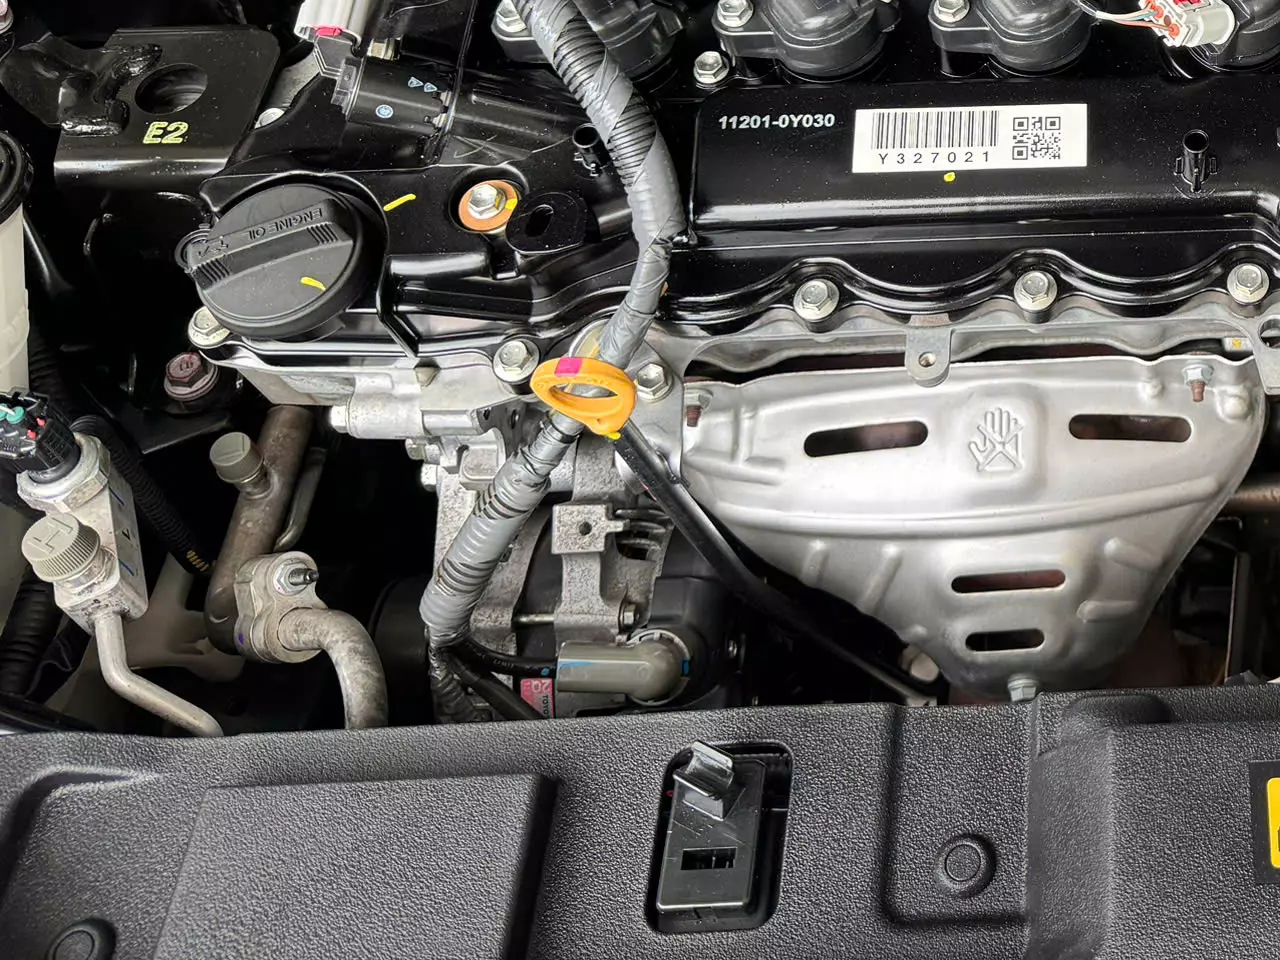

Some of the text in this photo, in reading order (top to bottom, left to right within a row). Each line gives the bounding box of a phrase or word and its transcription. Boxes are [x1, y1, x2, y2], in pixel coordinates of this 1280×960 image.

[718, 114, 835, 130] 11201-0Y030
[143, 121, 189, 144] E2
[878, 151, 991, 165] Y327021
[243, 208, 323, 241] ENGINE OIL
[542, 695, 550, 715] TOYO
